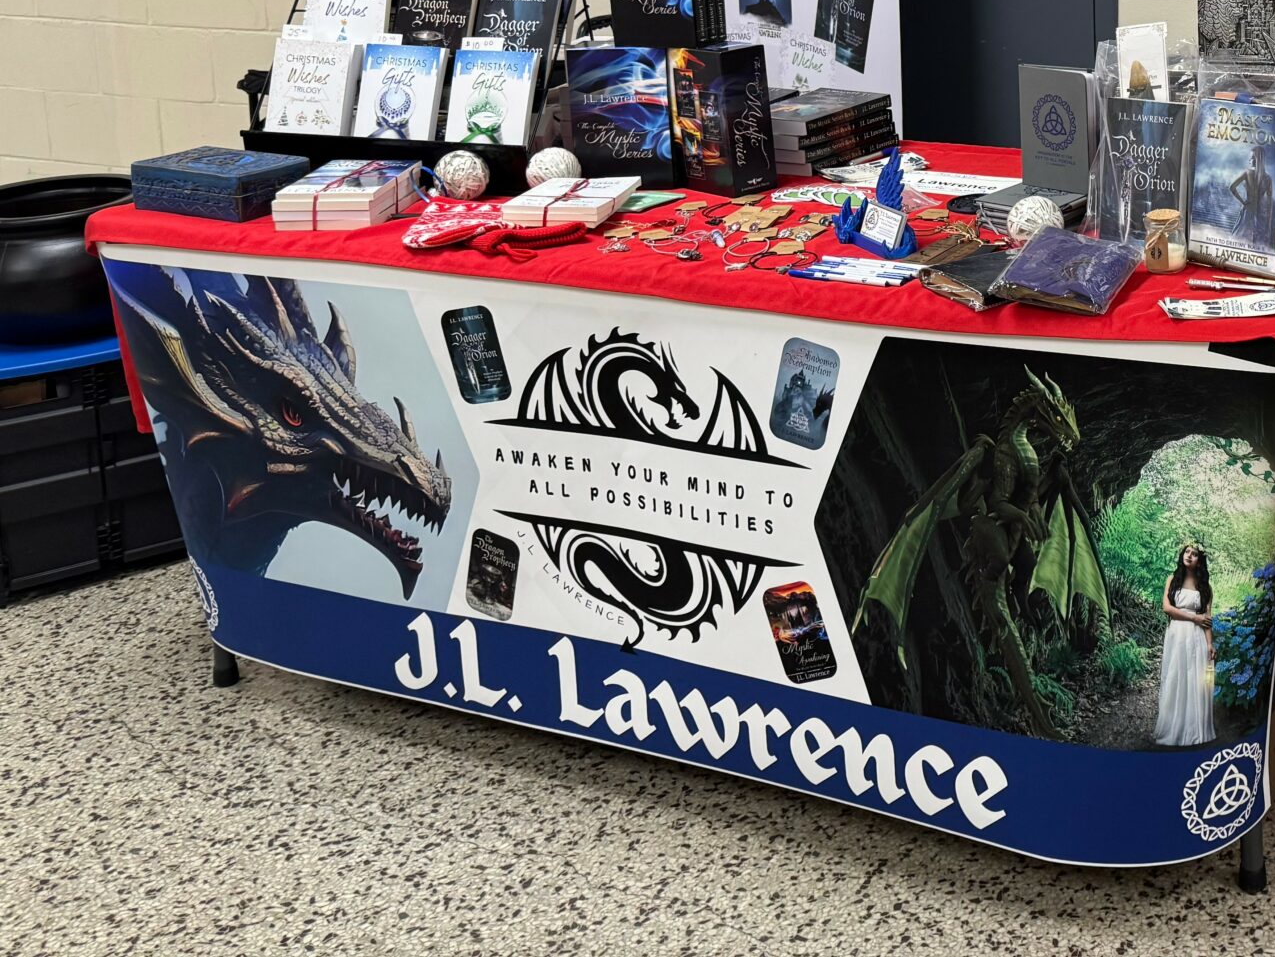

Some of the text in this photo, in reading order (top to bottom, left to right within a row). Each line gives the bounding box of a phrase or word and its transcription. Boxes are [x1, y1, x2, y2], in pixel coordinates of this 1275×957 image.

[325, 0, 369, 18] Wishes
[411, 8, 467, 28] Prophecy
[479, 13, 540, 37] Dagger
[516, 33, 530, 45] of
[789, 39, 827, 56] CHRISTMAS
[286, 53, 336, 66] CHRISTMAS
[375, 56, 427, 68] CHRISTMAS
[465, 61, 519, 72] CHRISTMAS
[791, 51, 823, 73] Wishes
[287, 66, 330, 85] Wishes
[381, 67, 416, 94] Gifts
[472, 72, 506, 94] Gifts
[293, 85, 321, 95] TRILOGY
[600, 94, 648, 103] Lawrence
[1118, 112, 1174, 125] J.L. LAWRENCE
[1218, 107, 1273, 128] MASK OF
[584, 128, 643, 146] Mystic
[733, 119, 749, 168] Series
[613, 145, 654, 159] Series
[1109, 135, 1169, 165] Dagger
[1147, 161, 1160, 176] of
[917, 178, 998, 191] Lawrence
[1133, 167, 1175, 192] Orion
[1216, 248, 1268, 267] LAWRENCE
[450, 331, 487, 346] Dagger
[471, 349, 498, 362] Orion
[495, 447, 793, 508] AWAKEN YOUR MIND TO
[529, 479, 774, 535] ALL POSSIBILITIES
[543, 562, 625, 626] LAWRENCE
[394, 611, 1010, 831] J.L. Lawrence
